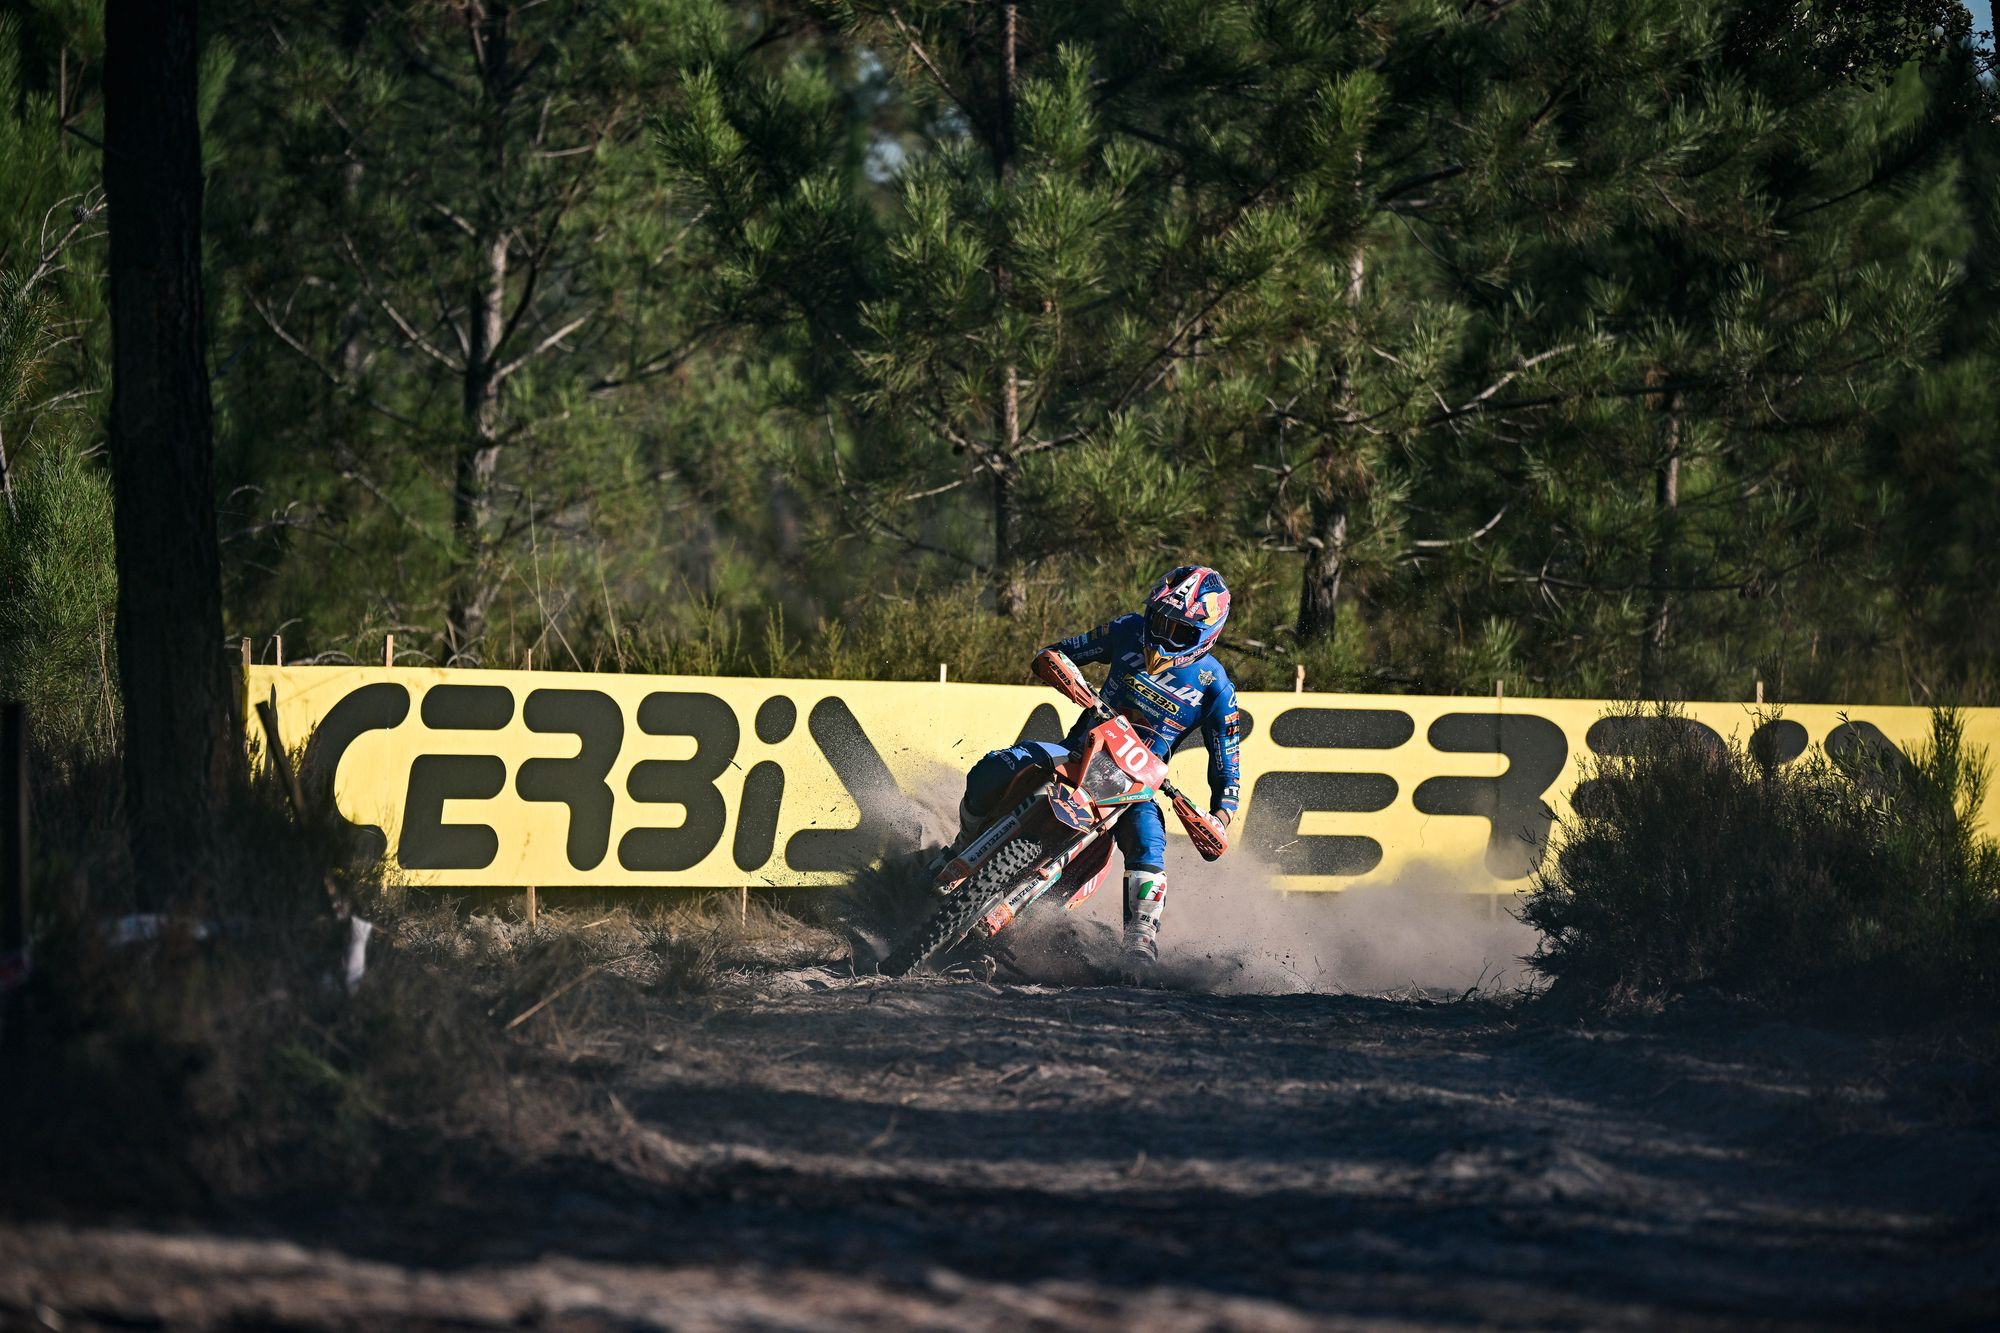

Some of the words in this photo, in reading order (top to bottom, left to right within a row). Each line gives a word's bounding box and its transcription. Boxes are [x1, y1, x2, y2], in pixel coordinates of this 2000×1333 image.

[1125, 677, 1179, 714] ACERBIS
[1115, 734, 1149, 772] 10
[975, 820, 1016, 858] METZELER
[1083, 875, 1098, 897] 10
